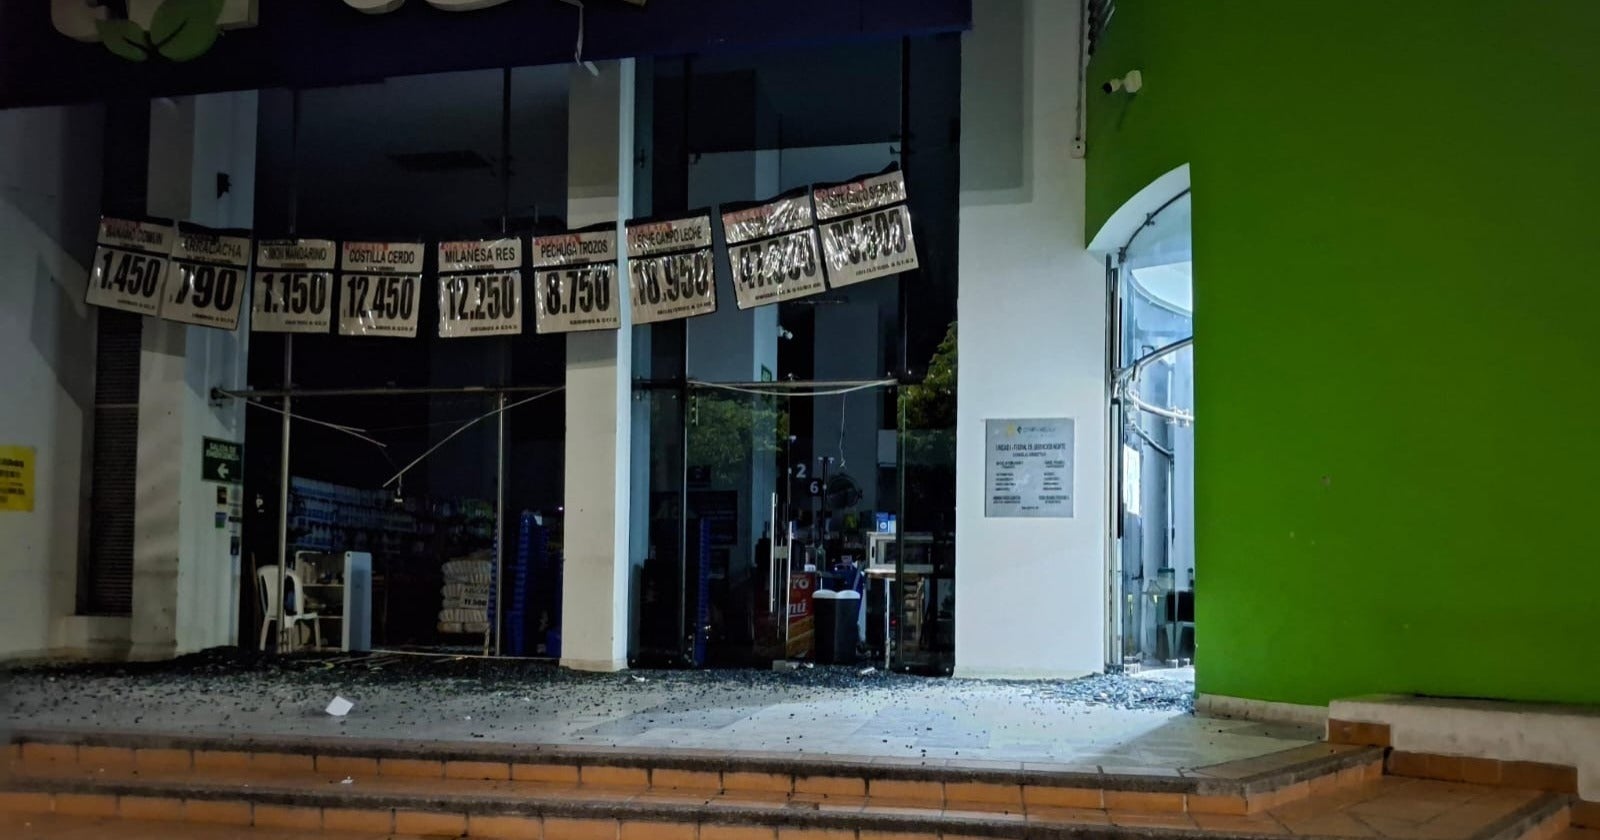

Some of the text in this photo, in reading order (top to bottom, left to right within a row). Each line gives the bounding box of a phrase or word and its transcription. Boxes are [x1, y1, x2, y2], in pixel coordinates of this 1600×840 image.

[680, 226, 702, 242] LECHE
[349, 249, 415, 264] COSTILLA CERDO
[444, 247, 515, 263] MILANESA RES
[540, 243, 578, 259] PECHUGA
[579, 239, 608, 255] TROZOS
[100, 250, 161, 298] 1.450
[175, 263, 237, 311] 790
[262, 274, 327, 315] 1.150
[546, 269, 610, 316] 8.750
[446, 275, 515, 321] 12.250
[795, 462, 807, 479] 2
[810, 480, 819, 494] 6
